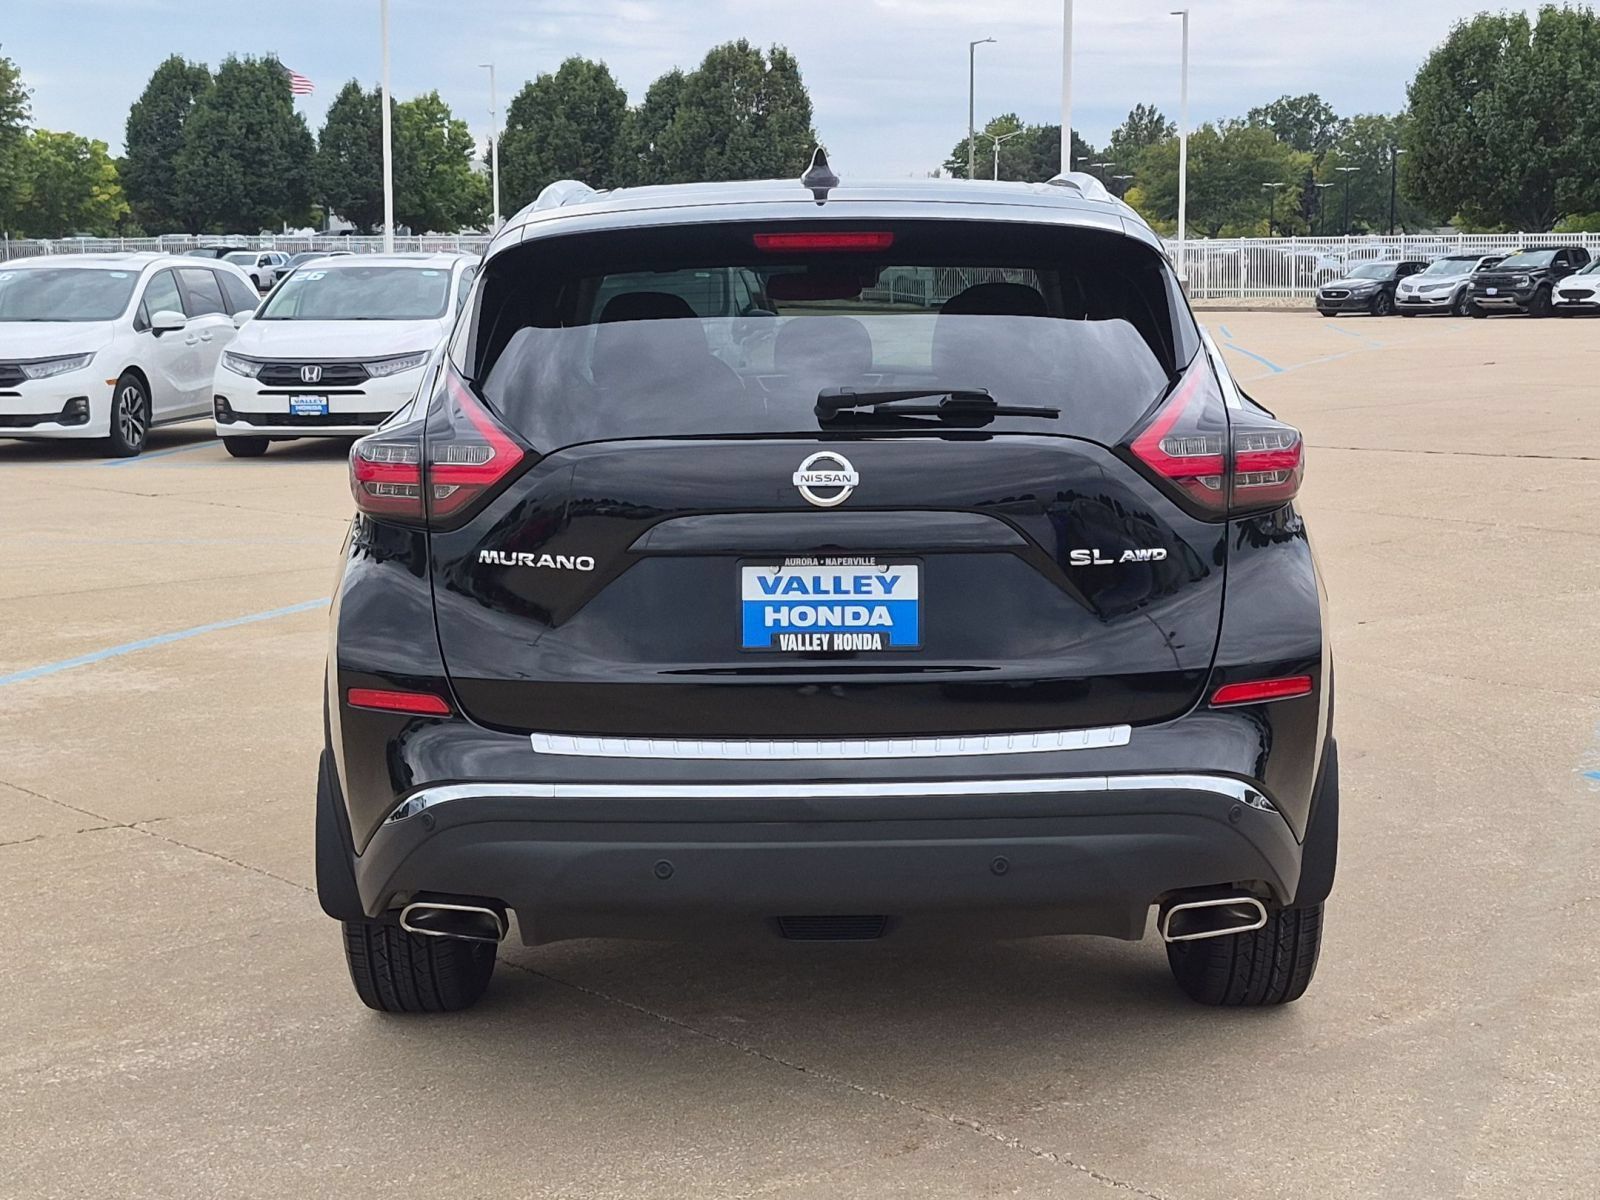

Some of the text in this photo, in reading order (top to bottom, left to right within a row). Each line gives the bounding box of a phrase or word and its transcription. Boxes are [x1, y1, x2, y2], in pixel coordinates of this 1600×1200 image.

[800, 474, 852, 483] NISSAN
[478, 549, 595, 571] MURANO
[784, 557, 876, 566] AURORA NAPERVILLE
[1069, 547, 1168, 566] SL AWD
[757, 575, 901, 595] VALLEY
[764, 606, 894, 627] HONDA
[779, 633, 882, 650] VALLEY HONDA
